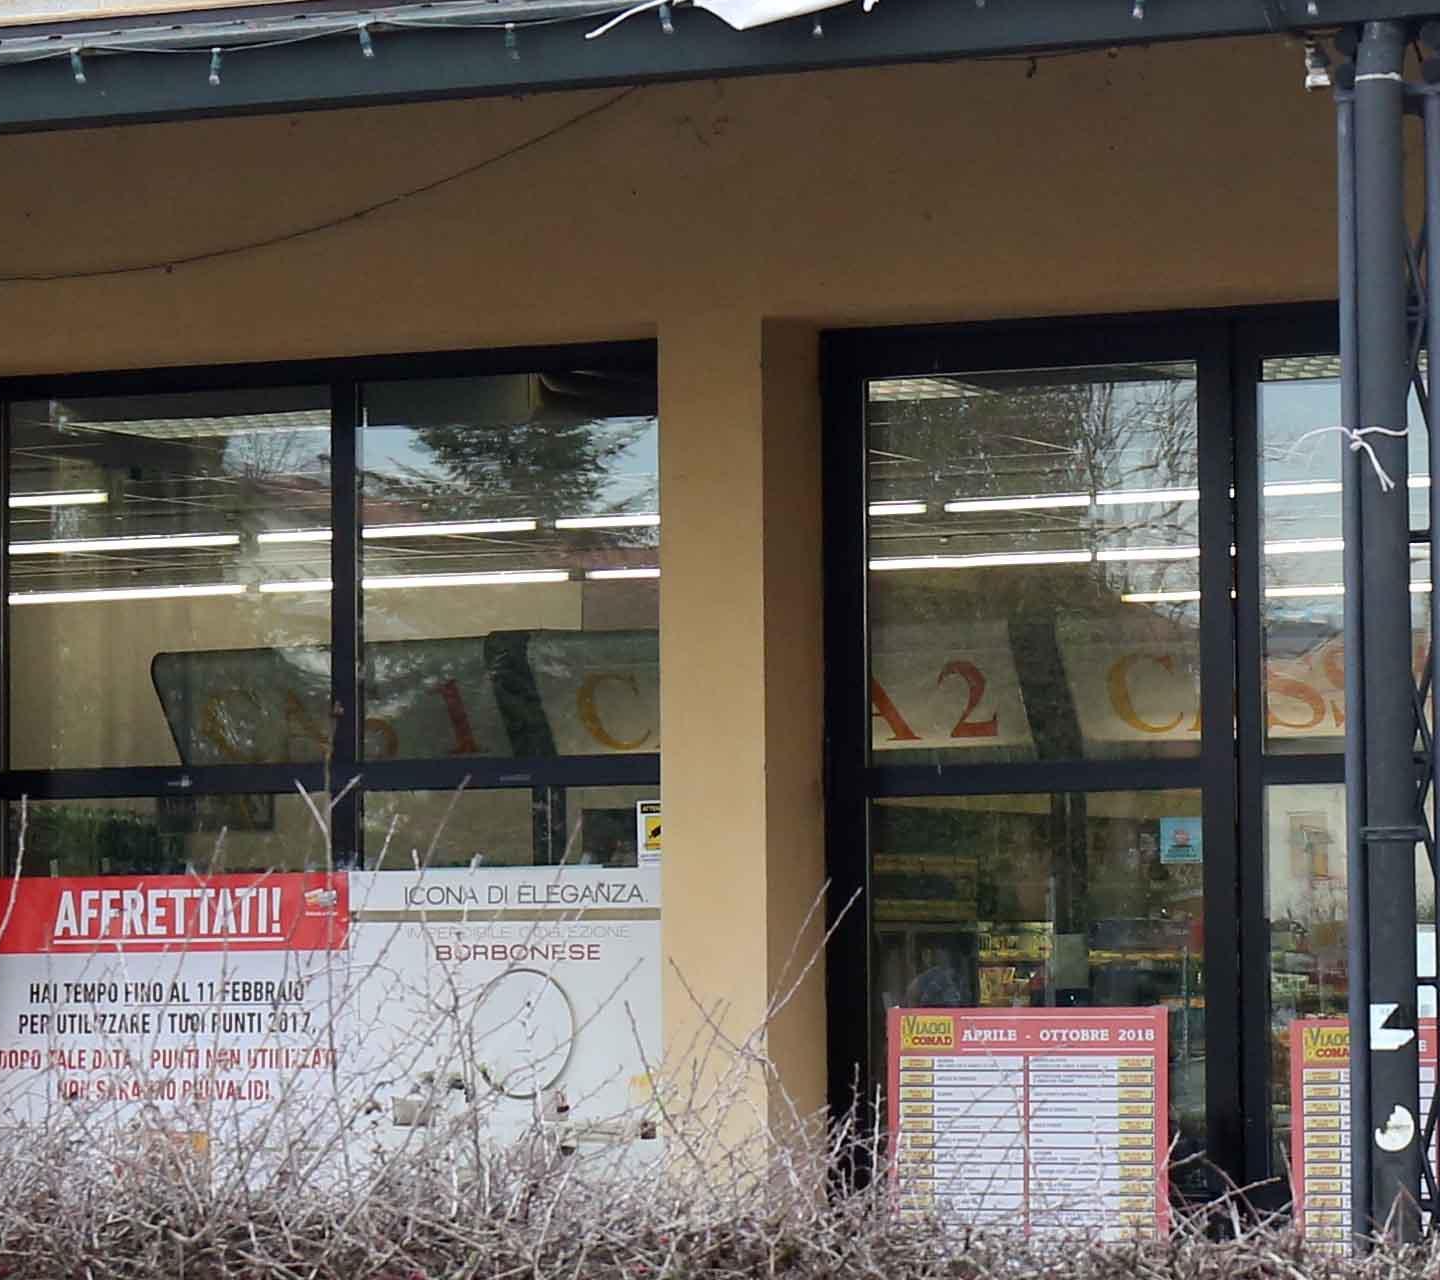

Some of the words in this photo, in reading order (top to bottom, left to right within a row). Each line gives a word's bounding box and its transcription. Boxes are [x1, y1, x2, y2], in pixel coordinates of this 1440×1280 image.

[404, 886, 478, 906] ICONA
[487, 885, 508, 905] DI
[53, 886, 282, 938] AFFRETTATI!
[29, 982, 59, 1004] HAI
[64, 982, 118, 1004] TEMPO
[124, 981, 163, 1003] FINO
[169, 981, 191, 1003] AL
[197, 981, 215, 1002] 11
[911, 1035, 953, 1047] CONAD
[961, 1028, 1017, 1042] APRILE
[1040, 1028, 1109, 1041] OTTOBRE
[1118, 1028, 1155, 1041] 2018
